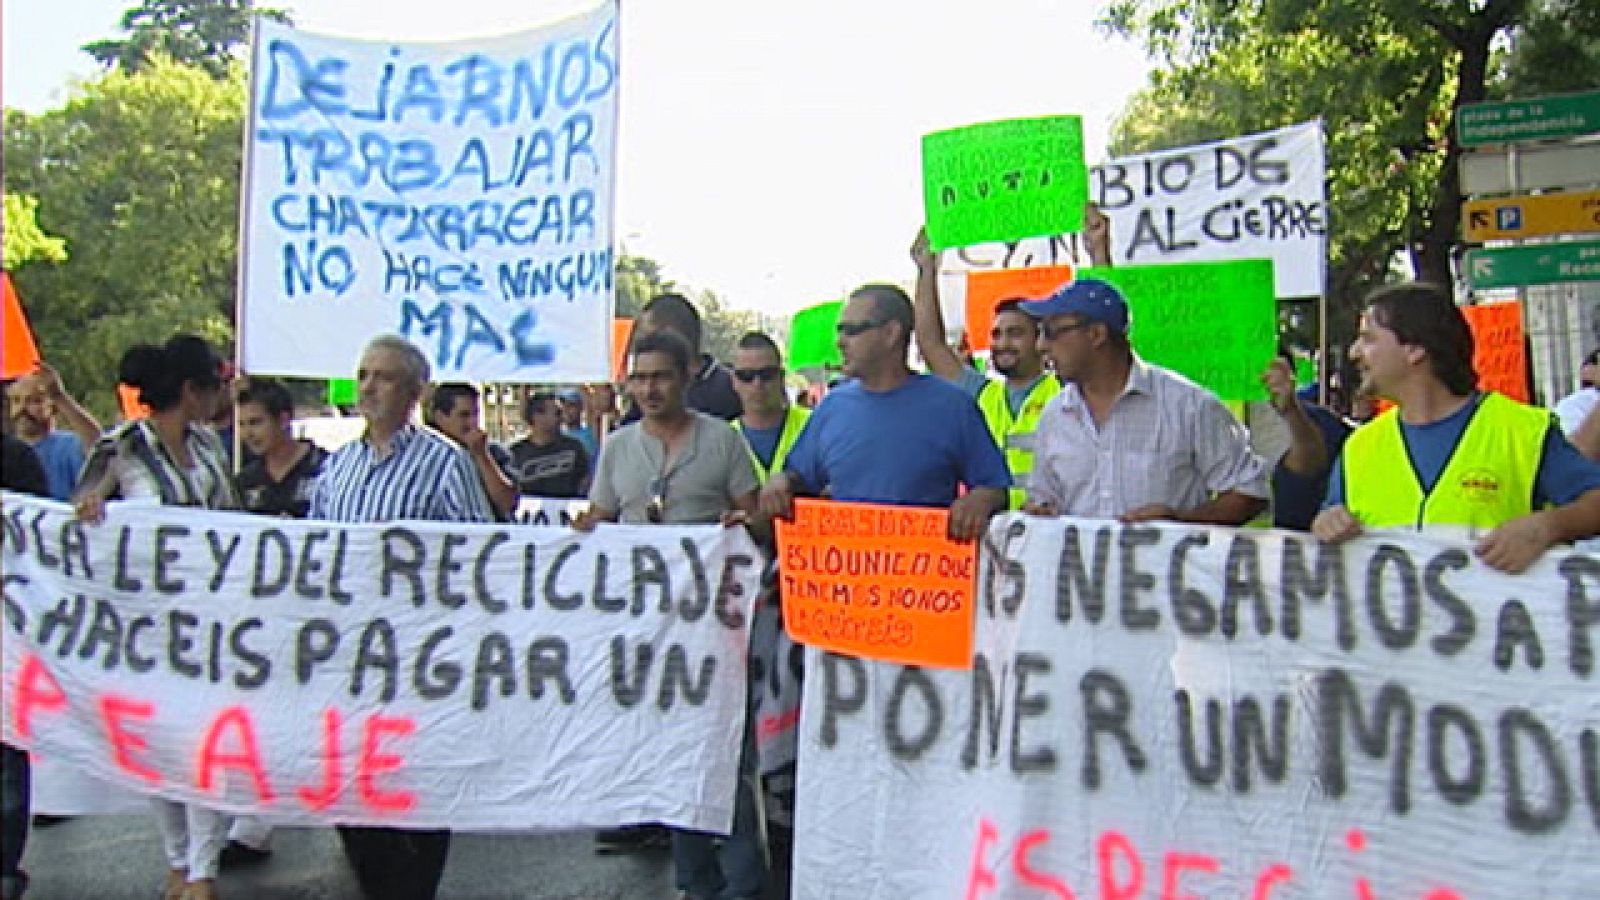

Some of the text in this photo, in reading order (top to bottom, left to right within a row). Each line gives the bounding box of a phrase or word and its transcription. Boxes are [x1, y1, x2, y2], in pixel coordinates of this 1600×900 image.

[257, 113, 599, 193] TRABAJAR
[283, 238, 355, 297] NO
[1125, 206, 1198, 261] AL
[380, 526, 754, 630] RECICLAJE
[1055, 523, 1479, 656] NEGAMOS
[37, 593, 272, 689] HACEIS
[294, 617, 577, 712] PAGAR
[609, 633, 717, 712] UN
[819, 651, 1148, 792] PONER
[1174, 688, 1292, 794] UN
